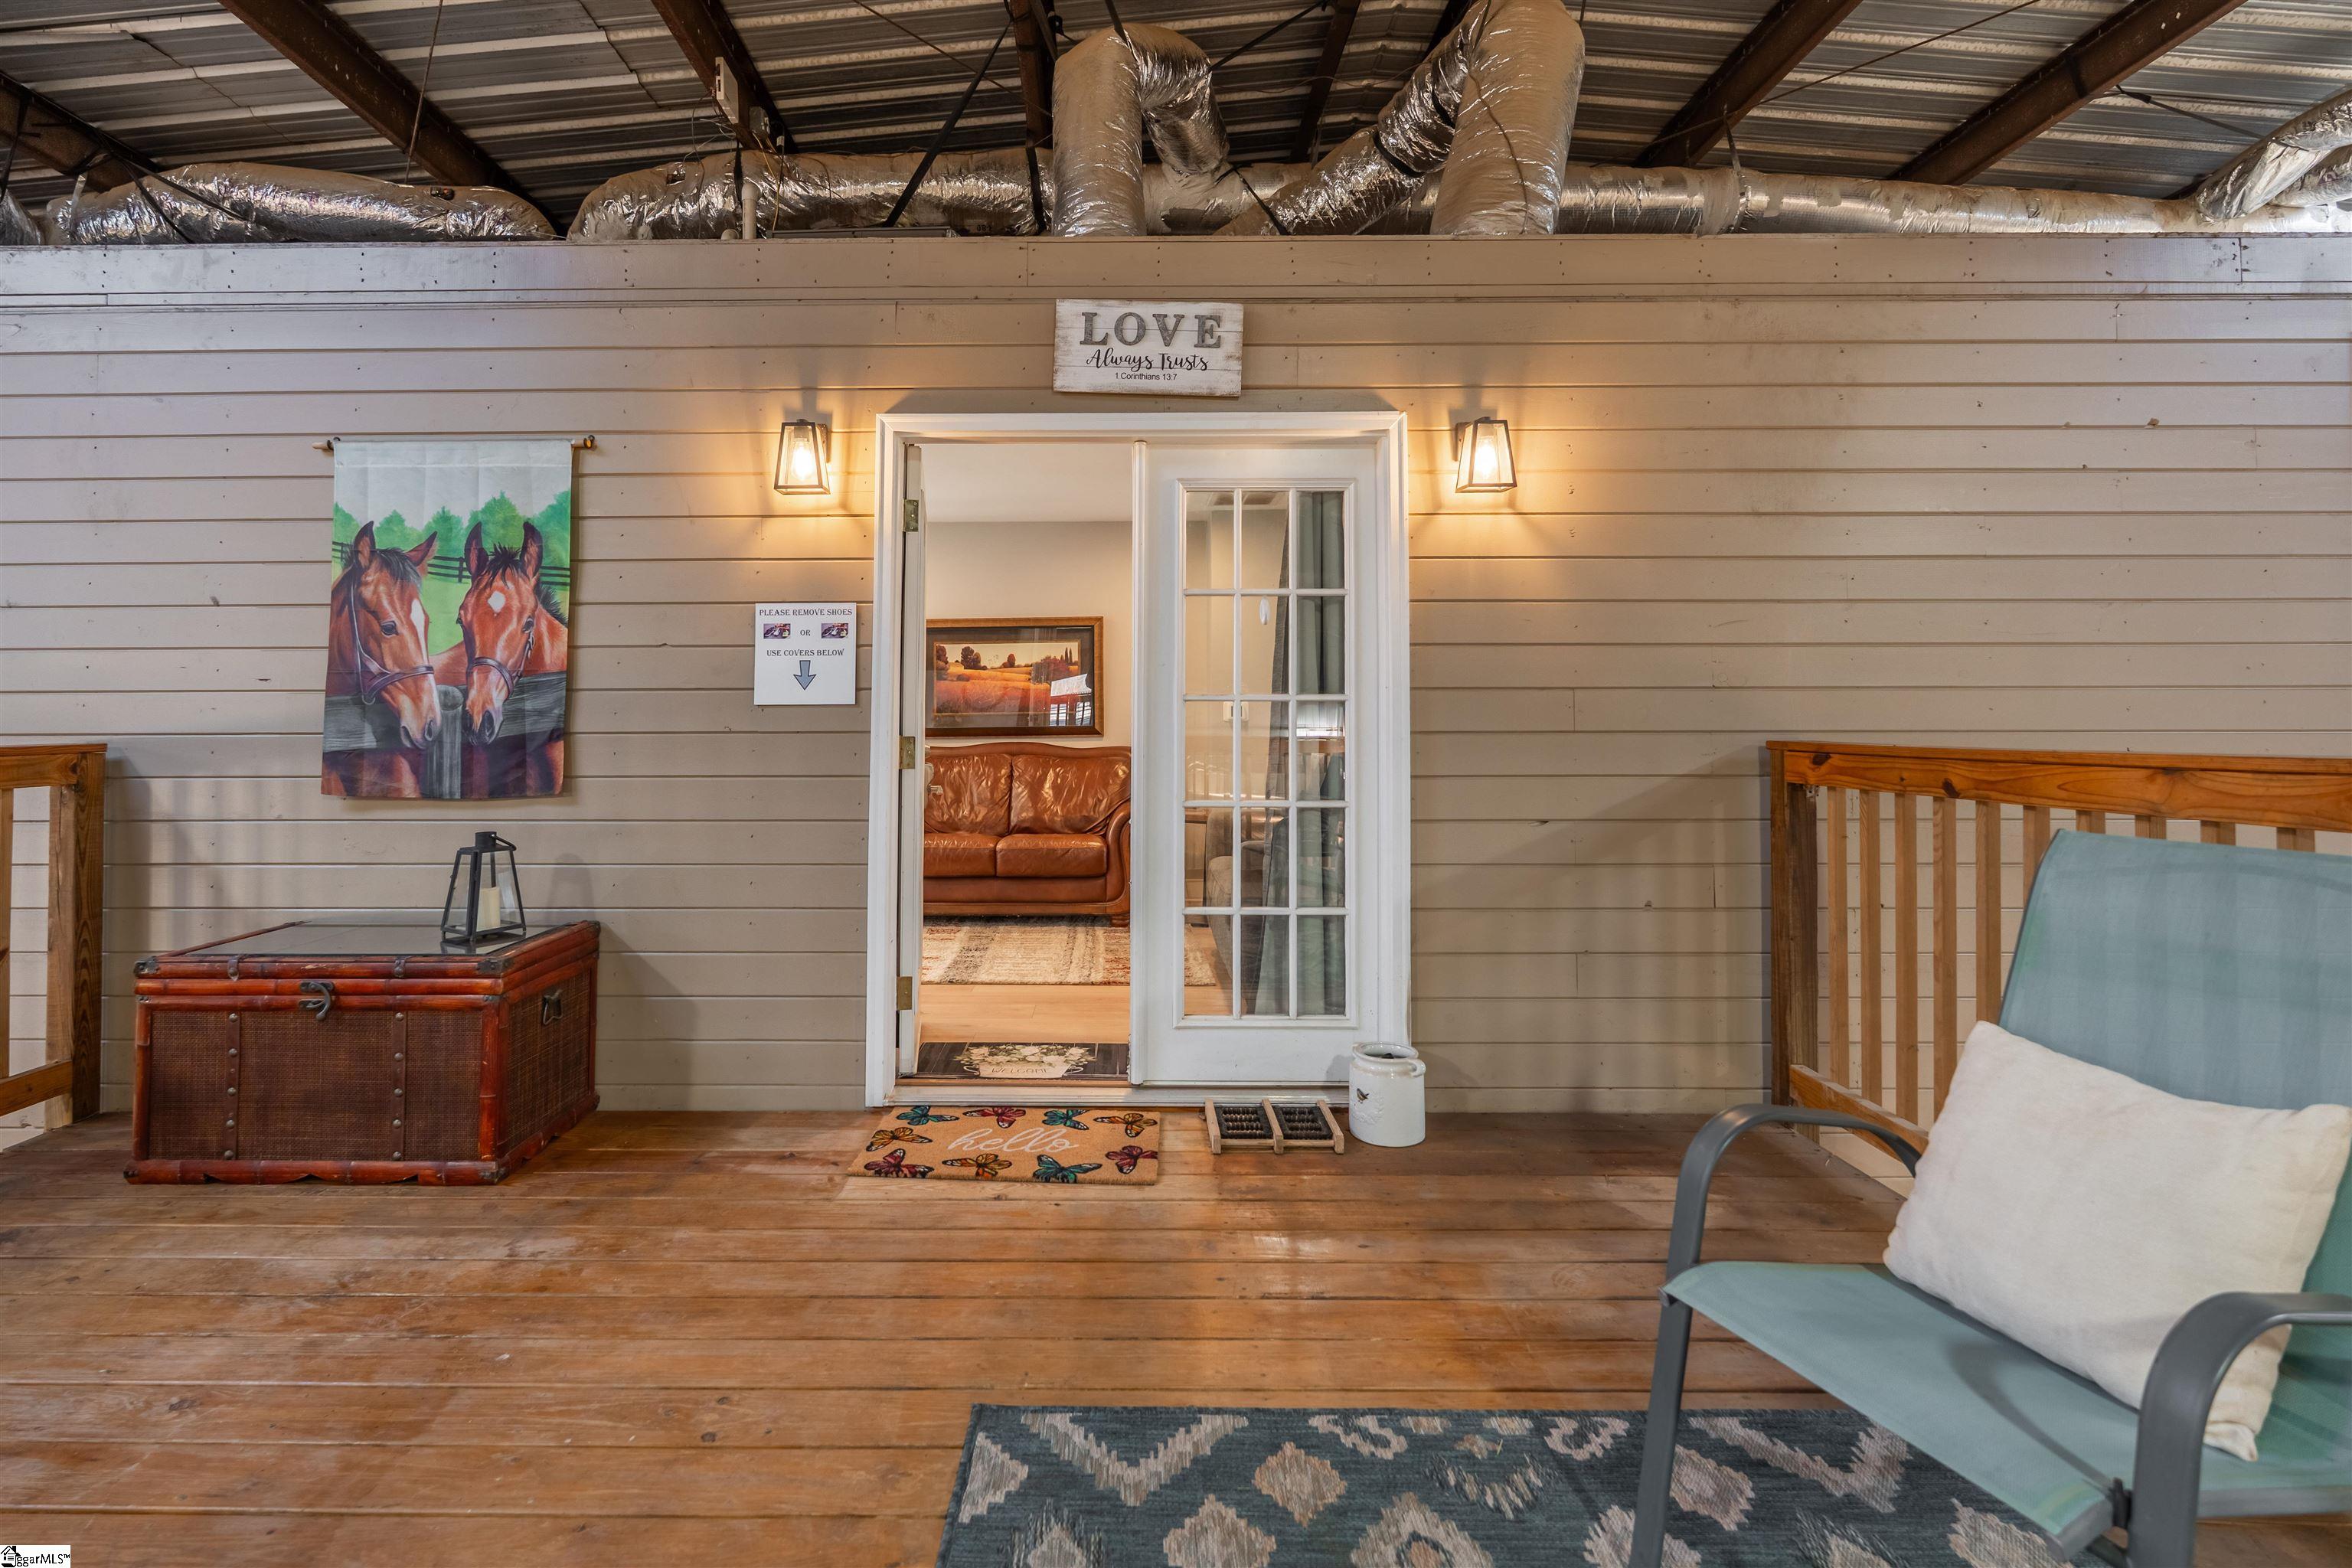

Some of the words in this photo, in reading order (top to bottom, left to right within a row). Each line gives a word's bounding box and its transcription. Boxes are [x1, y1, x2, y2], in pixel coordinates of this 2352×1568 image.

[1080, 312, 1221, 348] LOVE
[1086, 348, 1153, 372] Always
[1158, 353, 1209, 371] Trusts
[1120, 372, 1160, 381] Corinthians
[948, 1127, 1079, 1153] hello
